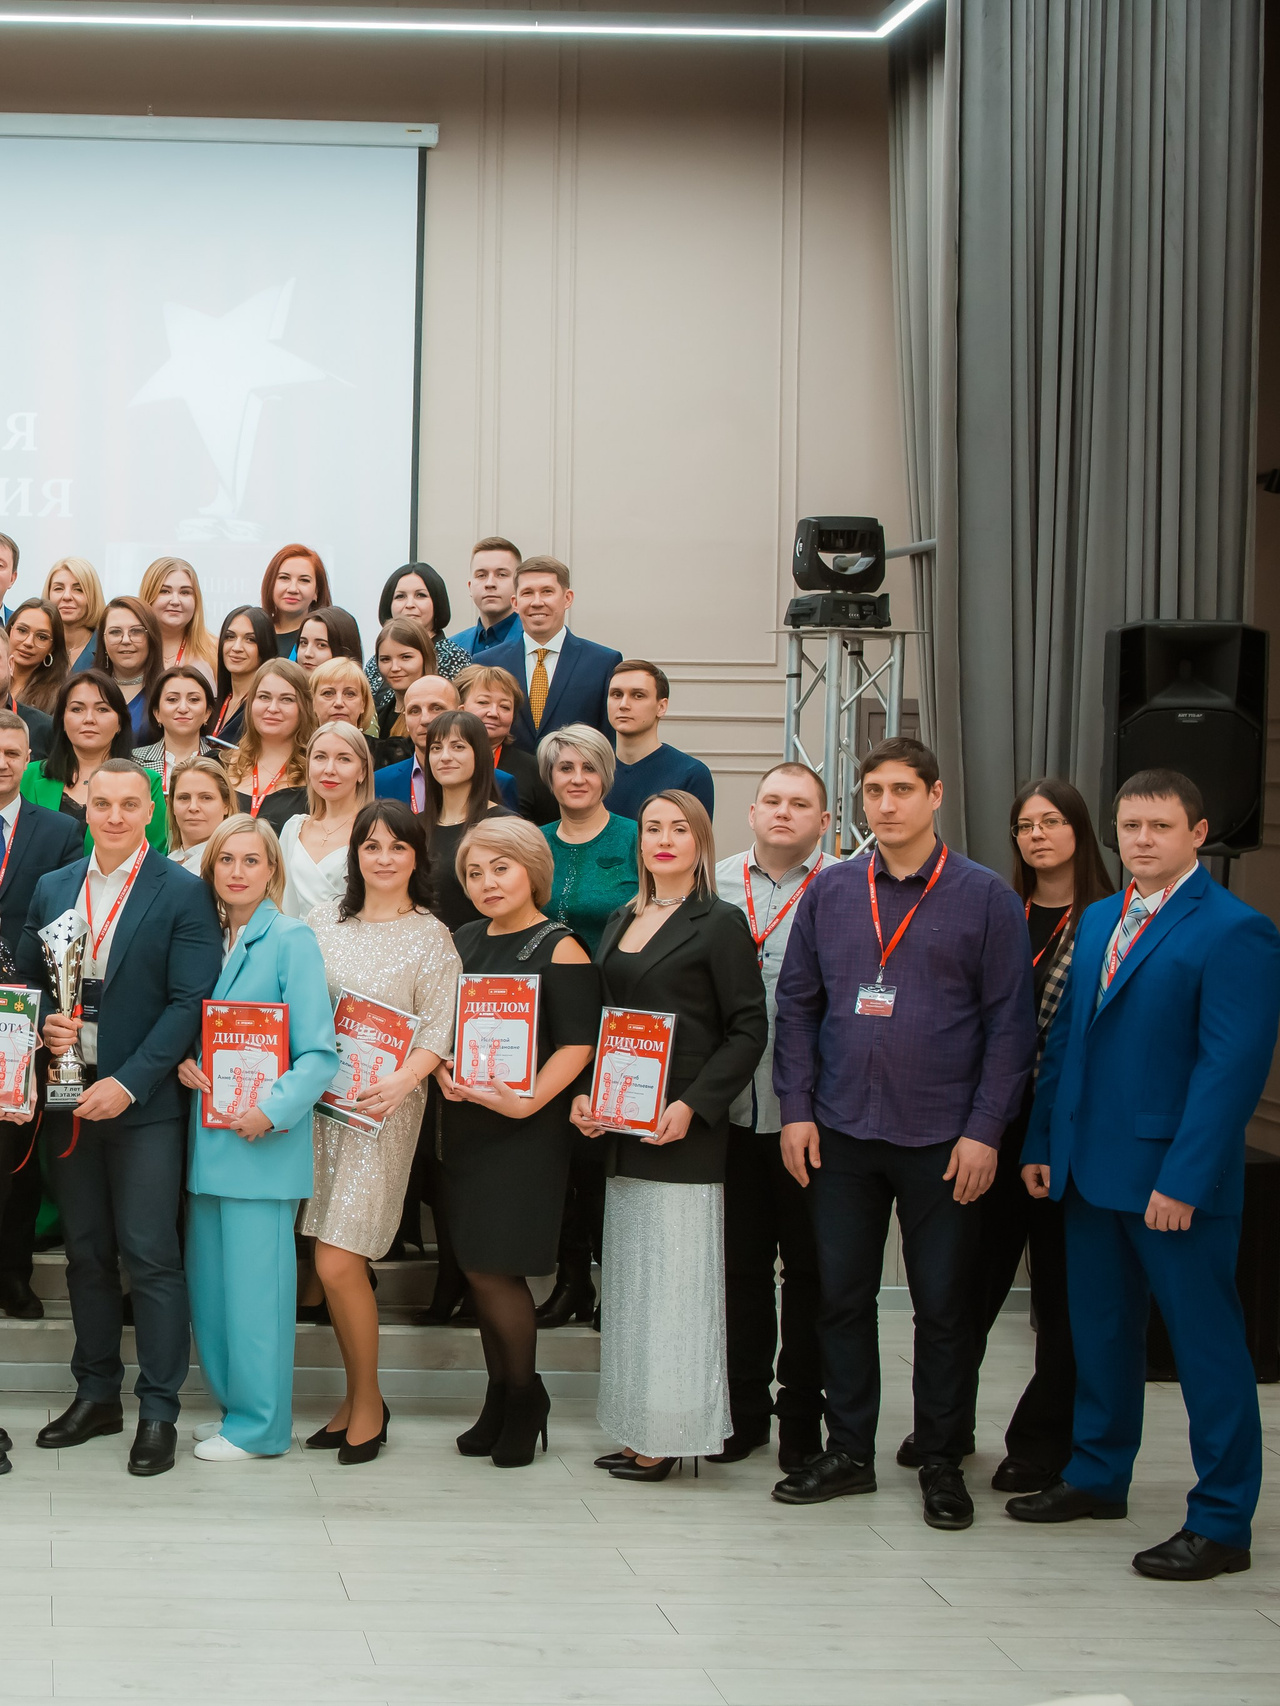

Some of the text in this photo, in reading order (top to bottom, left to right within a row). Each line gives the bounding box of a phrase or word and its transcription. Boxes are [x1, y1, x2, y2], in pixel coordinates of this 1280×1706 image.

[464, 1001, 531, 1014] ДИПЛОМ
[212, 1032, 279, 1046] ДИПЛОМ
[604, 1035, 665, 1053] ДИПЛОМ
